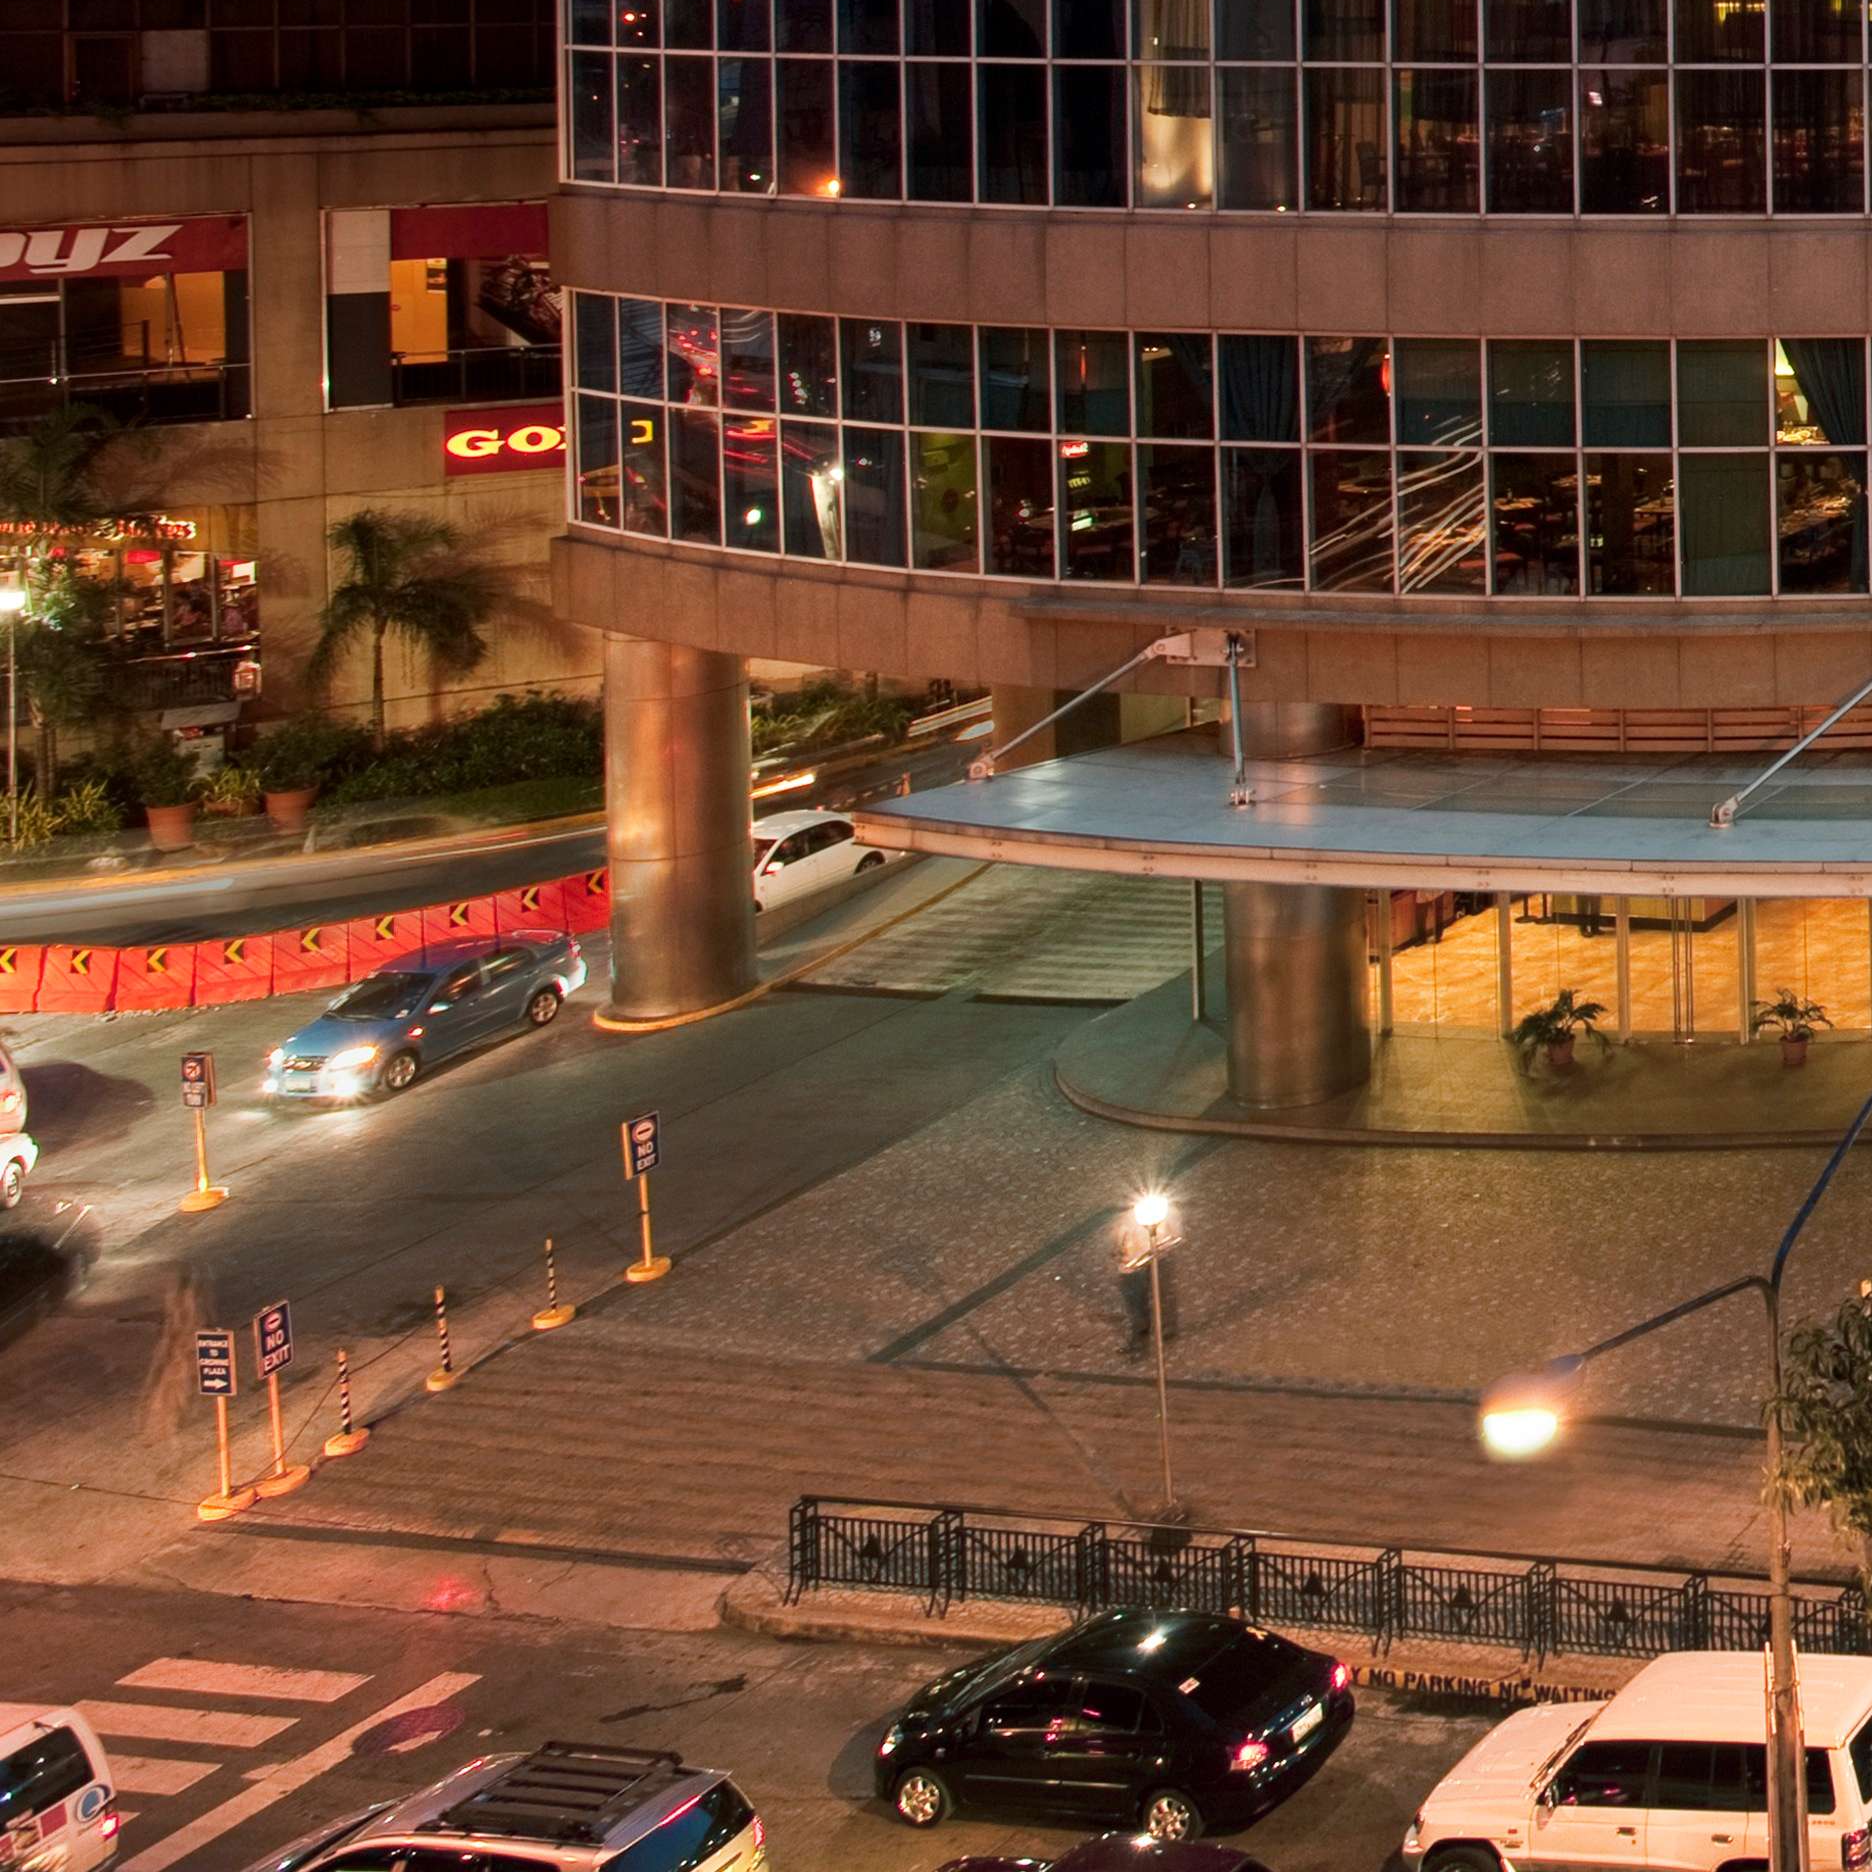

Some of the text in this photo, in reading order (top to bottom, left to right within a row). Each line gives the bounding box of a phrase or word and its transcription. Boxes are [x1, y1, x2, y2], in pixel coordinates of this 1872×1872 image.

[446, 424, 567, 458] GO
[636, 1153, 656, 1171] EXIT
[638, 1141, 653, 1158] NO
[265, 1329, 285, 1352] NO
[264, 1343, 290, 1371] EXIT
[1369, 1669, 1396, 1688] NO
[1404, 1671, 1490, 1697] PARKING
